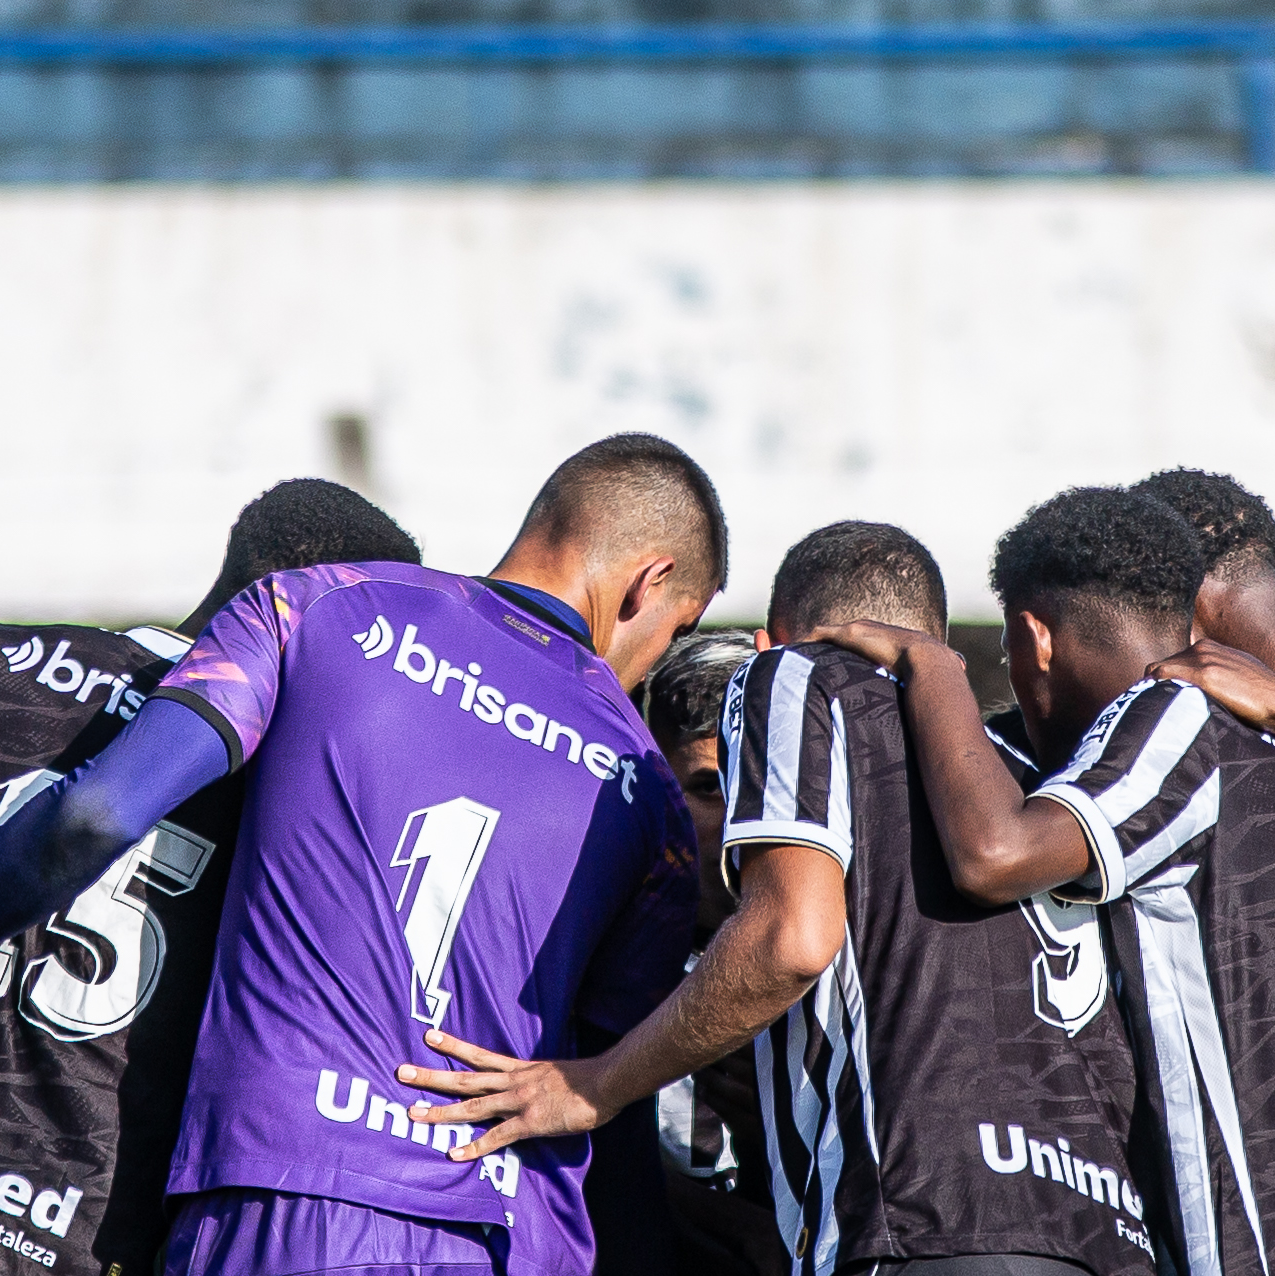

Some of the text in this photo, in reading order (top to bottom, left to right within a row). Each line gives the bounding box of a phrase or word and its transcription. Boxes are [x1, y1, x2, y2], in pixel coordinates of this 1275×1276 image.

[392, 623, 638, 804] brisanet
[389, 795, 503, 1032] 1
[314, 1067, 521, 1199] Unimd
